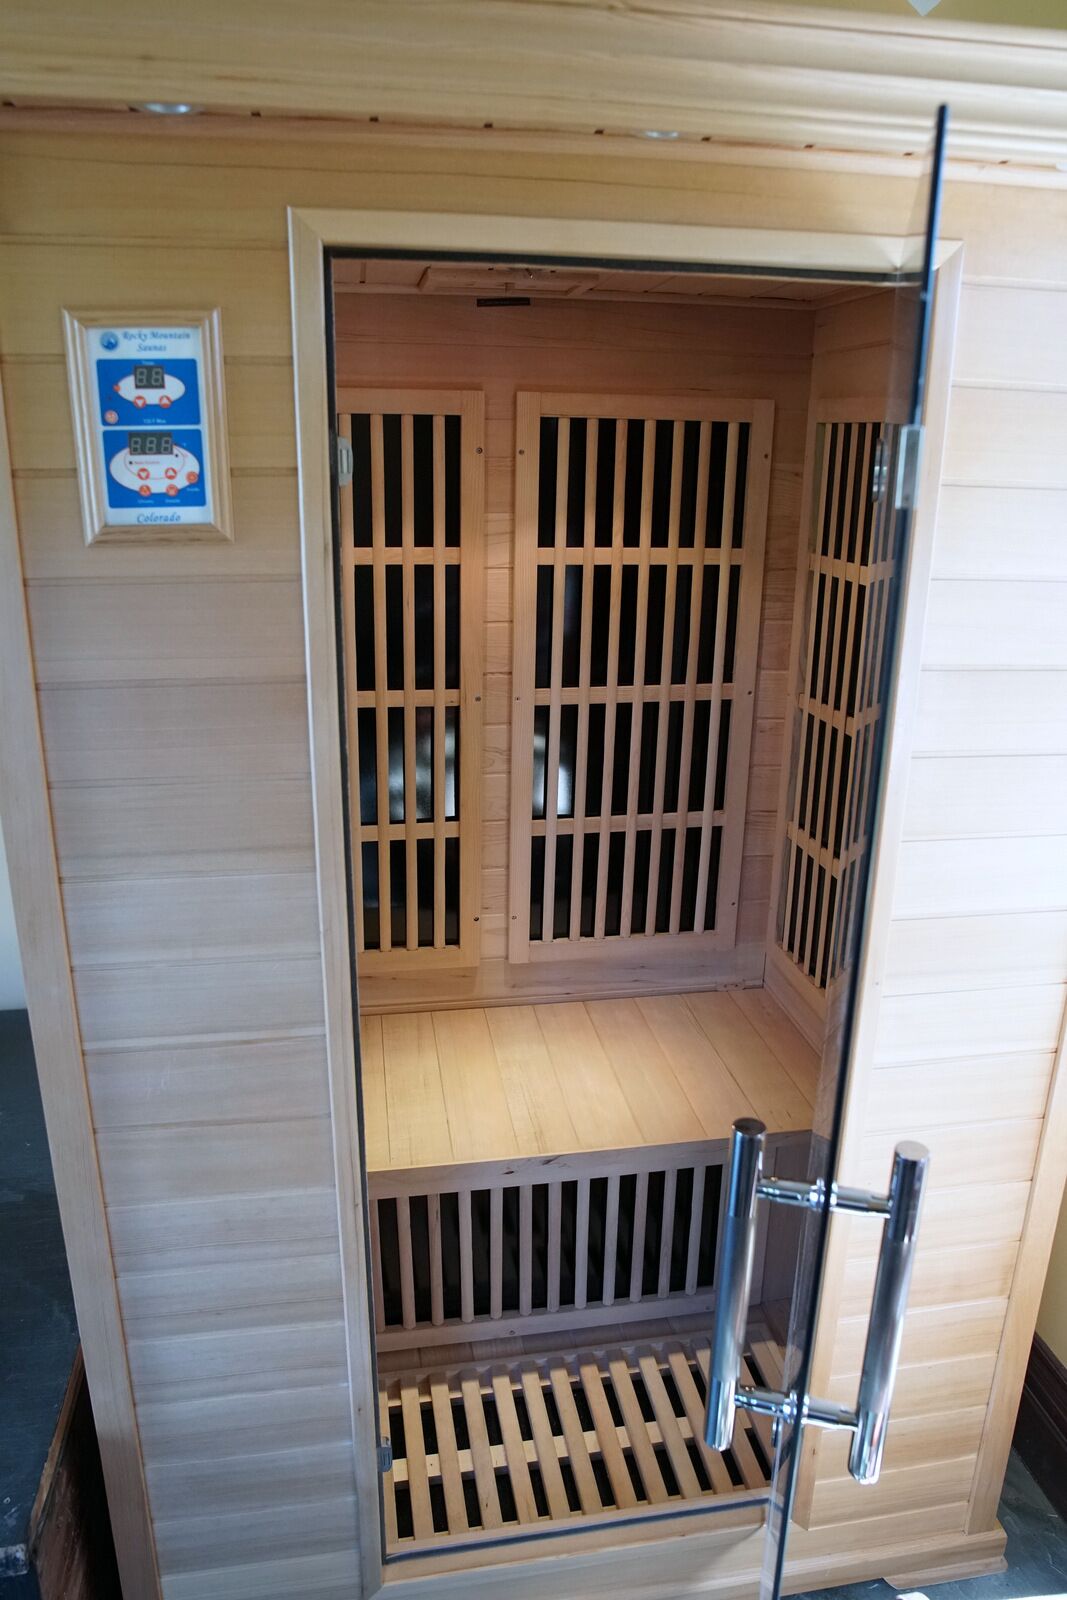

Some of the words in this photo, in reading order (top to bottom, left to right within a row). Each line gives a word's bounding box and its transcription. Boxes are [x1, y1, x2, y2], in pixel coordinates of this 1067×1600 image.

[122, 331, 147, 342] Rocky
[150, 331, 191, 340] Mountain
[136, 343, 167, 352] Saunas
[136, 511, 182, 524] Colorado
